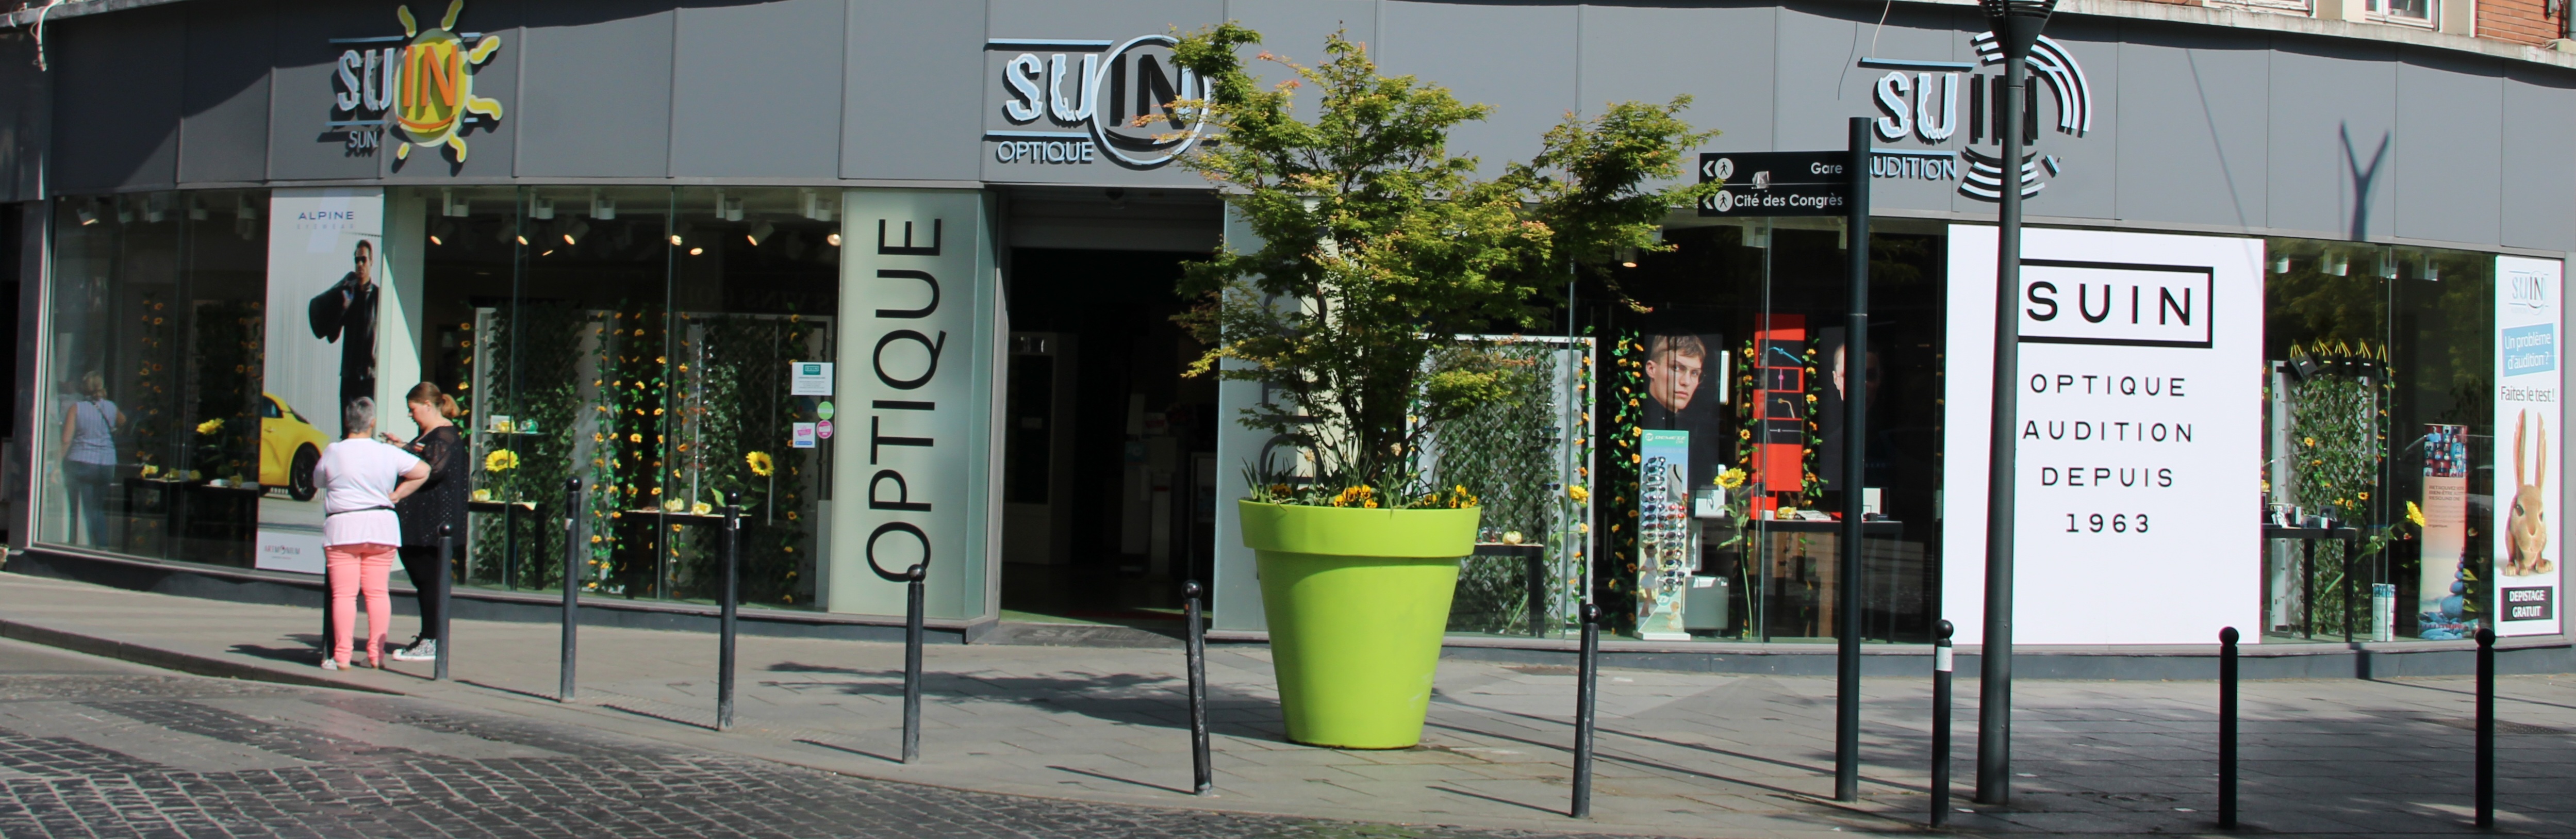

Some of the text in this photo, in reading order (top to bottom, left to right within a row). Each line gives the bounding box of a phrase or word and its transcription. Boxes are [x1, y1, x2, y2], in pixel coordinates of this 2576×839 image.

[337, 45, 459, 111] SUIN
[1006, 53, 1192, 130] SUIN
[349, 130, 379, 149] SUN
[997, 140, 1095, 161] OPTIQUE
[1810, 161, 1843, 174] Gare
[1870, 156, 1957, 179] UDITION
[1734, 192, 1843, 208] Cité des Congrès
[298, 211, 354, 220] ALPINE
[2026, 281, 2191, 326] SUIN
[2504, 331, 2552, 352] Un problème
[2029, 373, 2186, 397] OPTIQUE
[2501, 385, 2525, 401] Faites
[2527, 386, 2534, 401] le
[866, 218, 946, 583] OPTIQUE
[2022, 420, 2193, 443] AUDITION
[2041, 467, 2173, 487] DEPUIS
[2065, 513, 2150, 533] 1963
[2509, 589, 2546, 602] DEPISTAGE
[2512, 605, 2542, 618] GRATUIT
